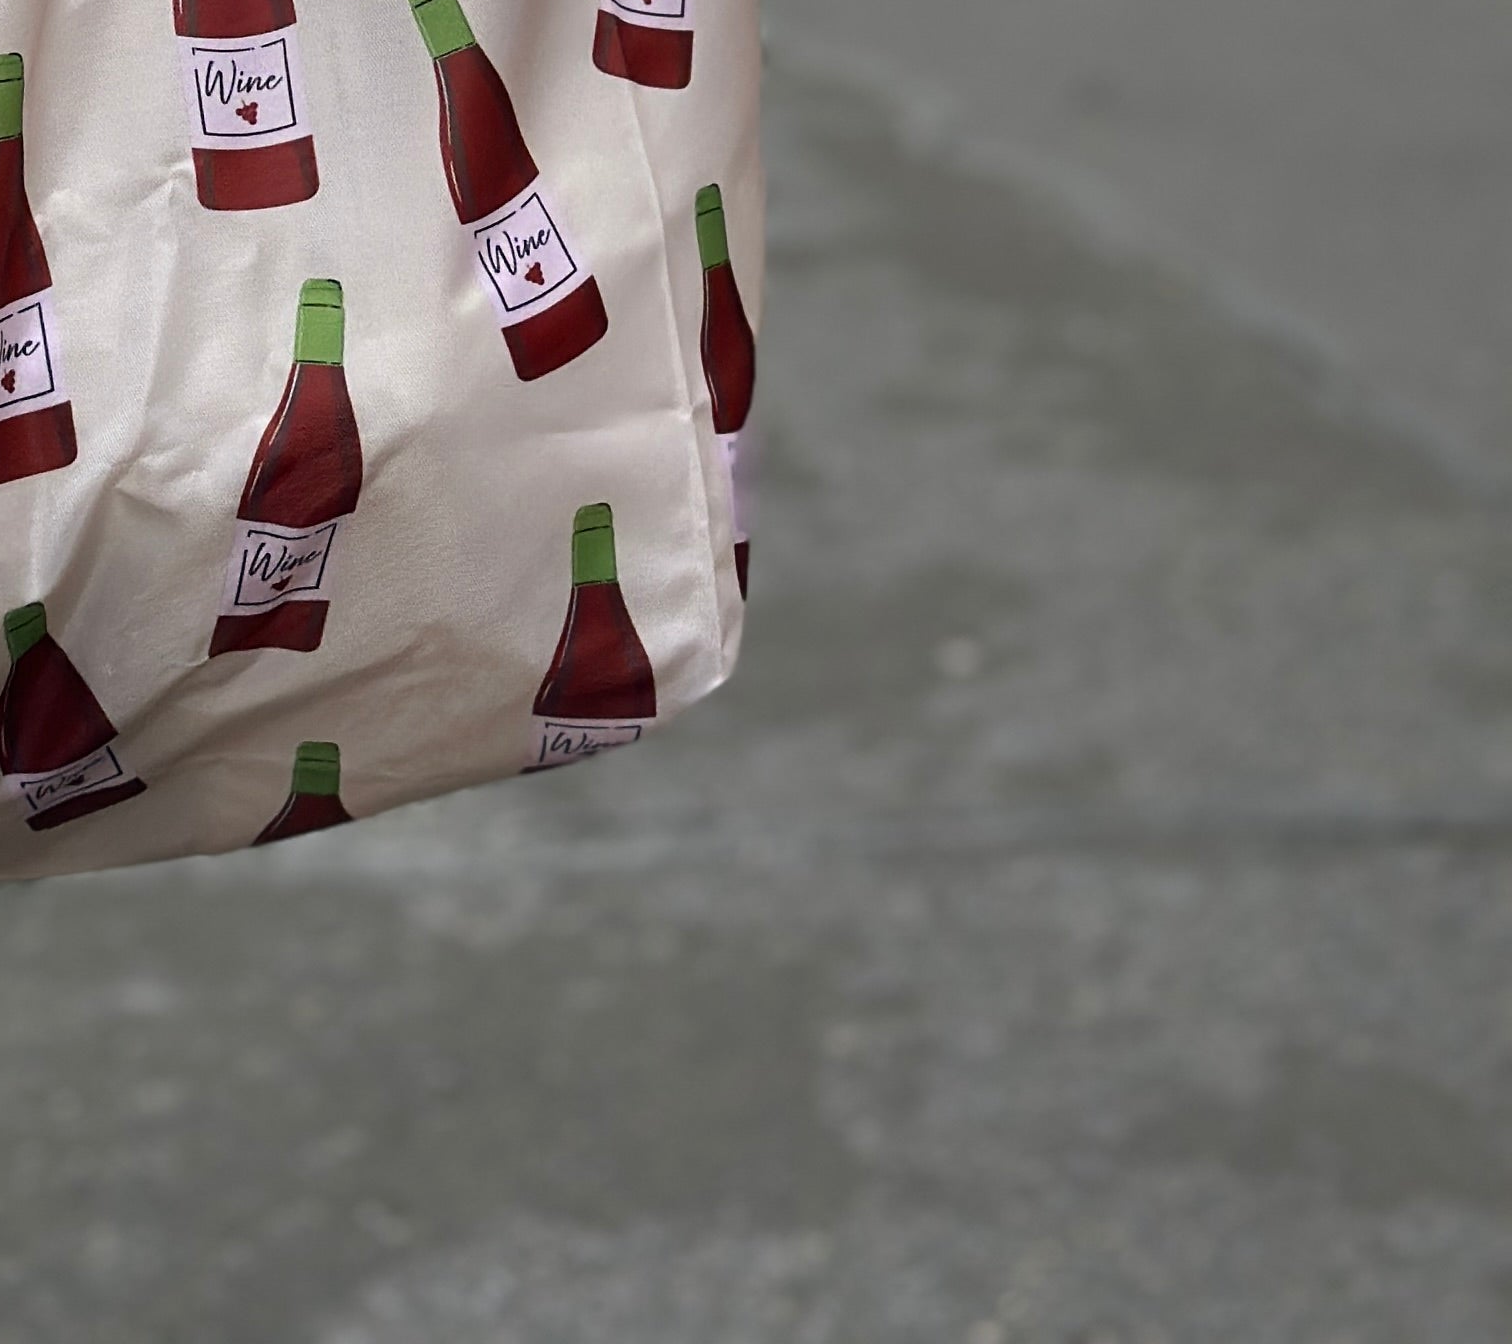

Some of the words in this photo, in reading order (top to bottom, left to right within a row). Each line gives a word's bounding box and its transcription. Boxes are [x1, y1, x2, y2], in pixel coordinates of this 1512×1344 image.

[205, 60, 283, 104] Wine
[487, 229, 551, 275] Wine
[249, 543, 320, 581] Wine
